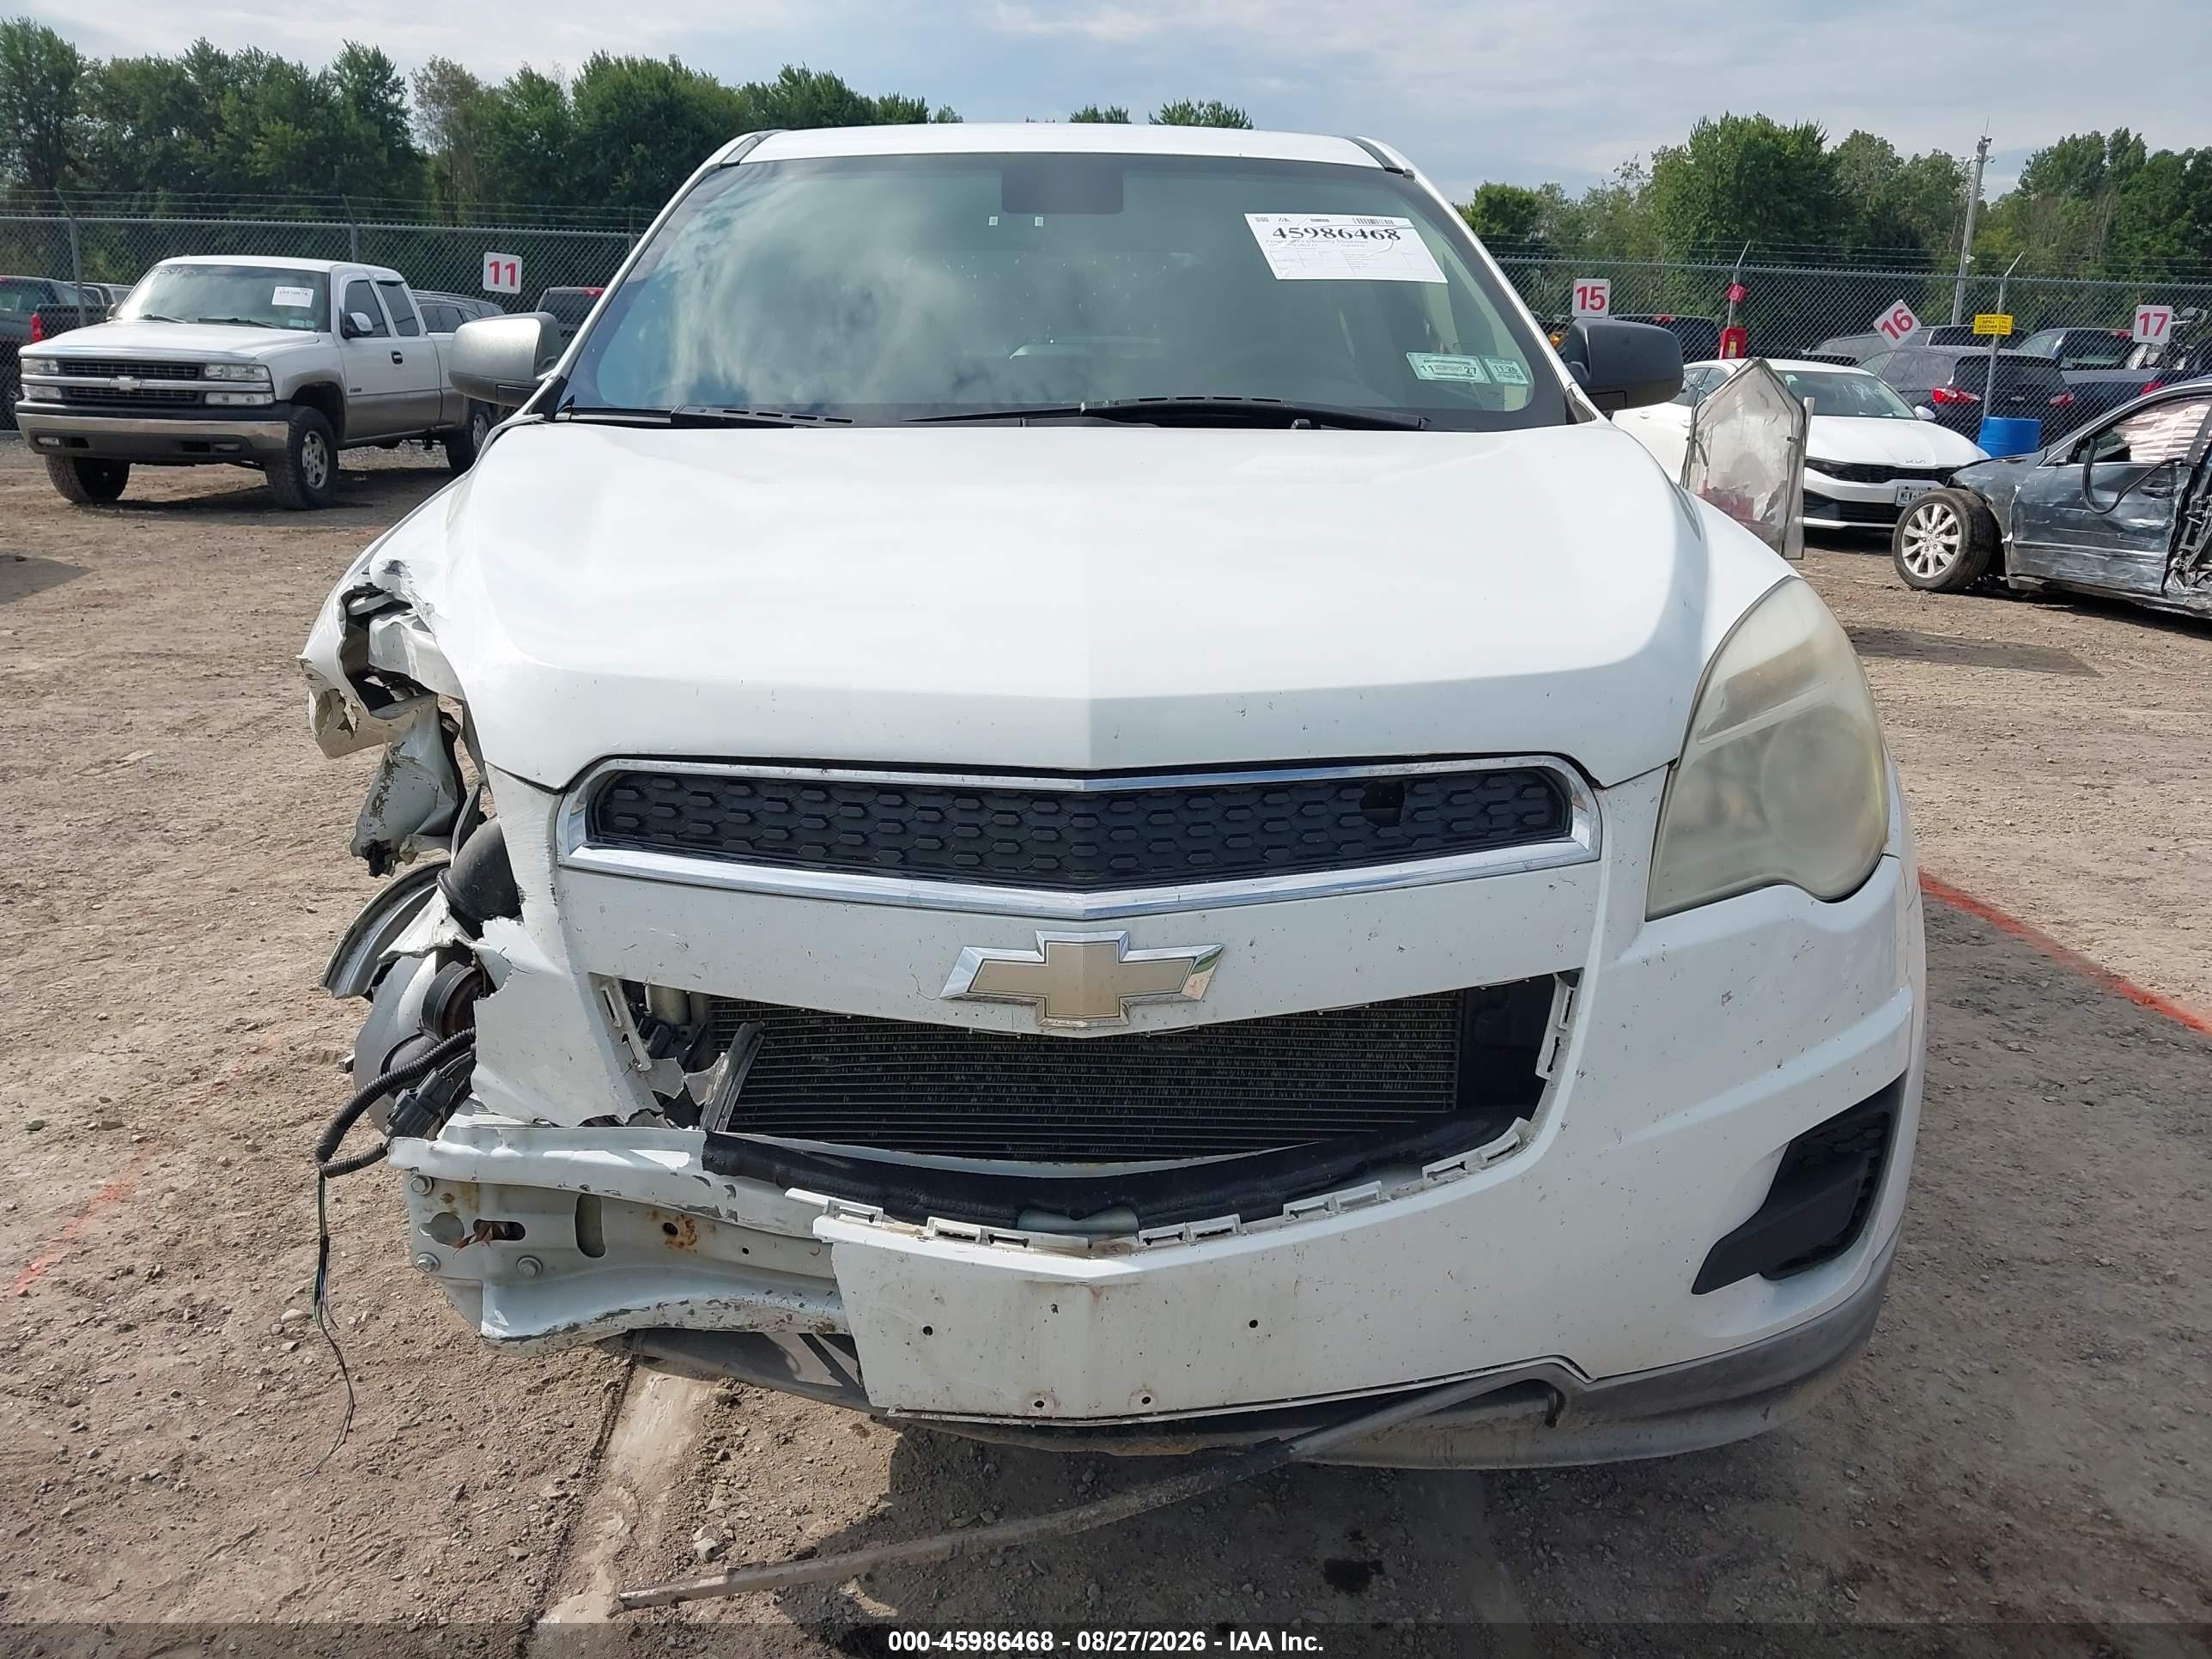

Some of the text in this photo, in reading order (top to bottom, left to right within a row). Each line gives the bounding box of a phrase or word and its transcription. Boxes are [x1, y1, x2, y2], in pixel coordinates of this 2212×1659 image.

[1273, 228, 1401, 240] 45986468
[489, 260, 516, 287] 11
[1576, 285, 1606, 311] 15
[1881, 308, 1914, 340] 16
[2139, 312, 2169, 337] 17
[1419, 364, 1436, 373] 11
[1463, 366, 1478, 375] 27
